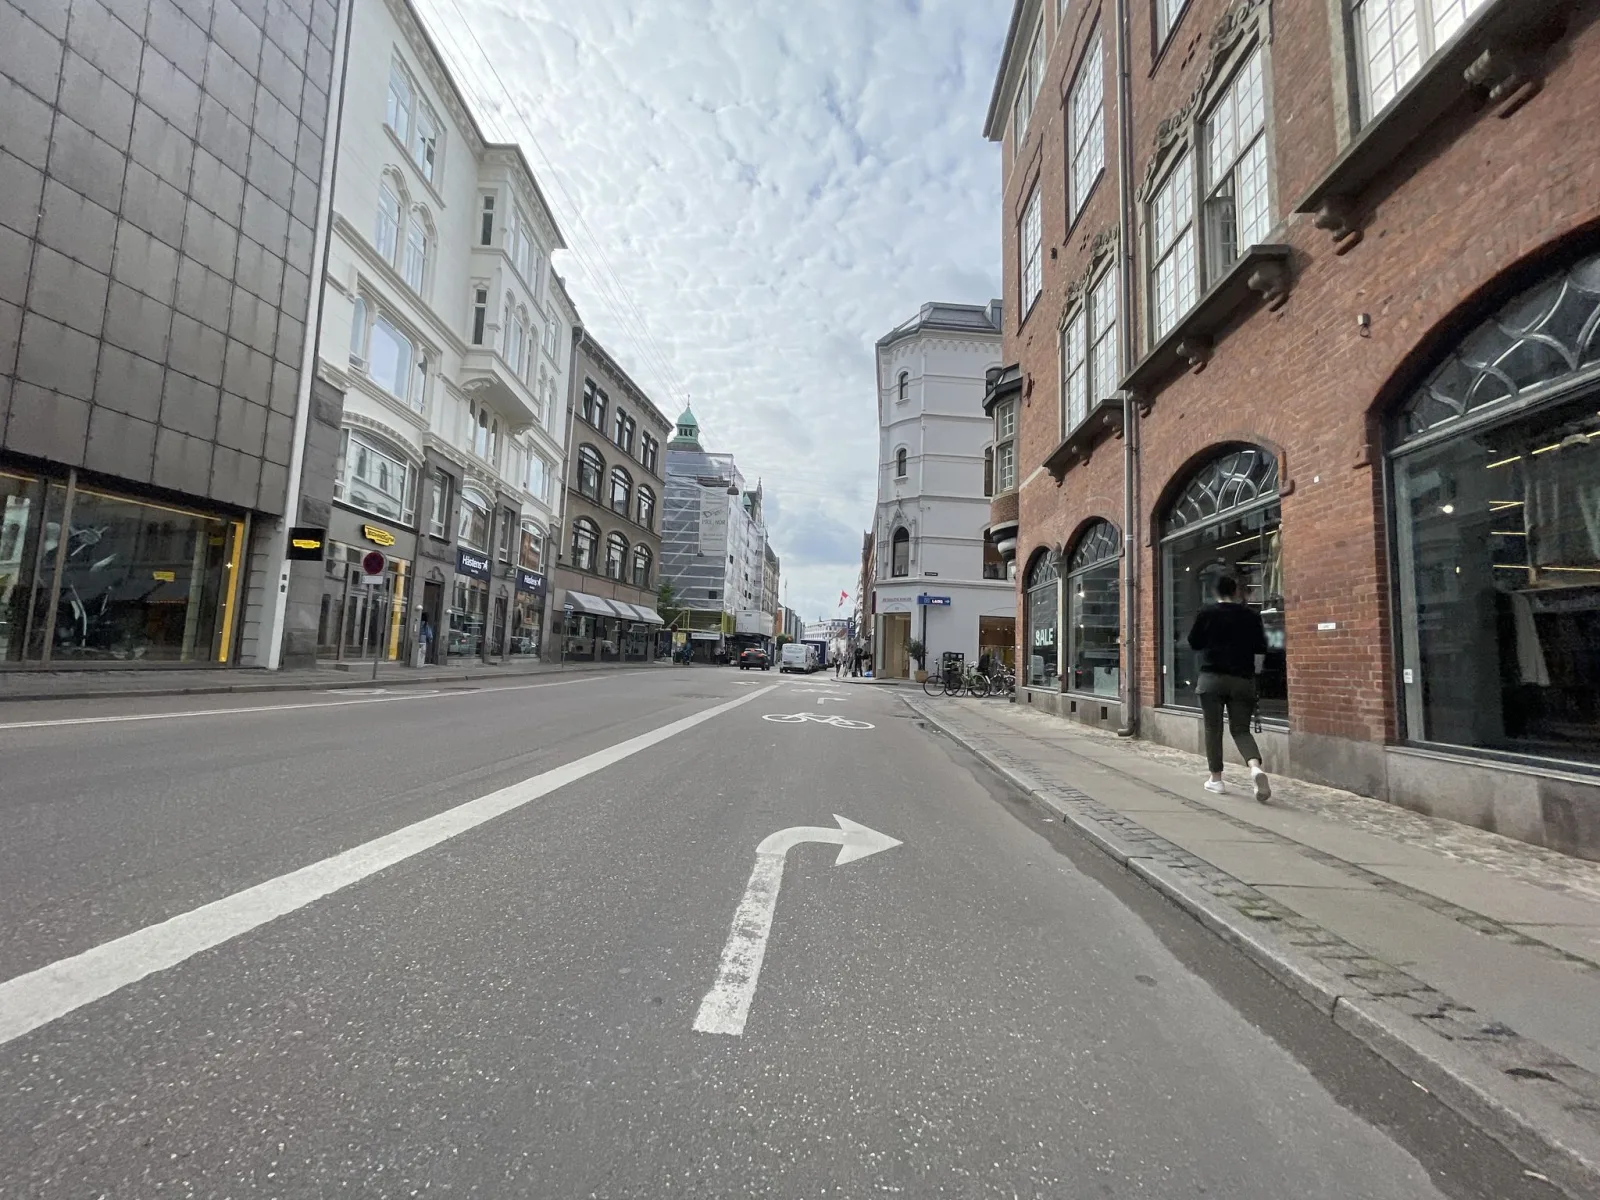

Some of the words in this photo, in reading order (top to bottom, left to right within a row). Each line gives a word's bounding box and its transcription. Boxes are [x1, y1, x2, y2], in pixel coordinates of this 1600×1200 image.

[462, 554, 482, 570] Hästens
[849, 621, 855, 629] P
[1035, 628, 1054, 646] SALE
